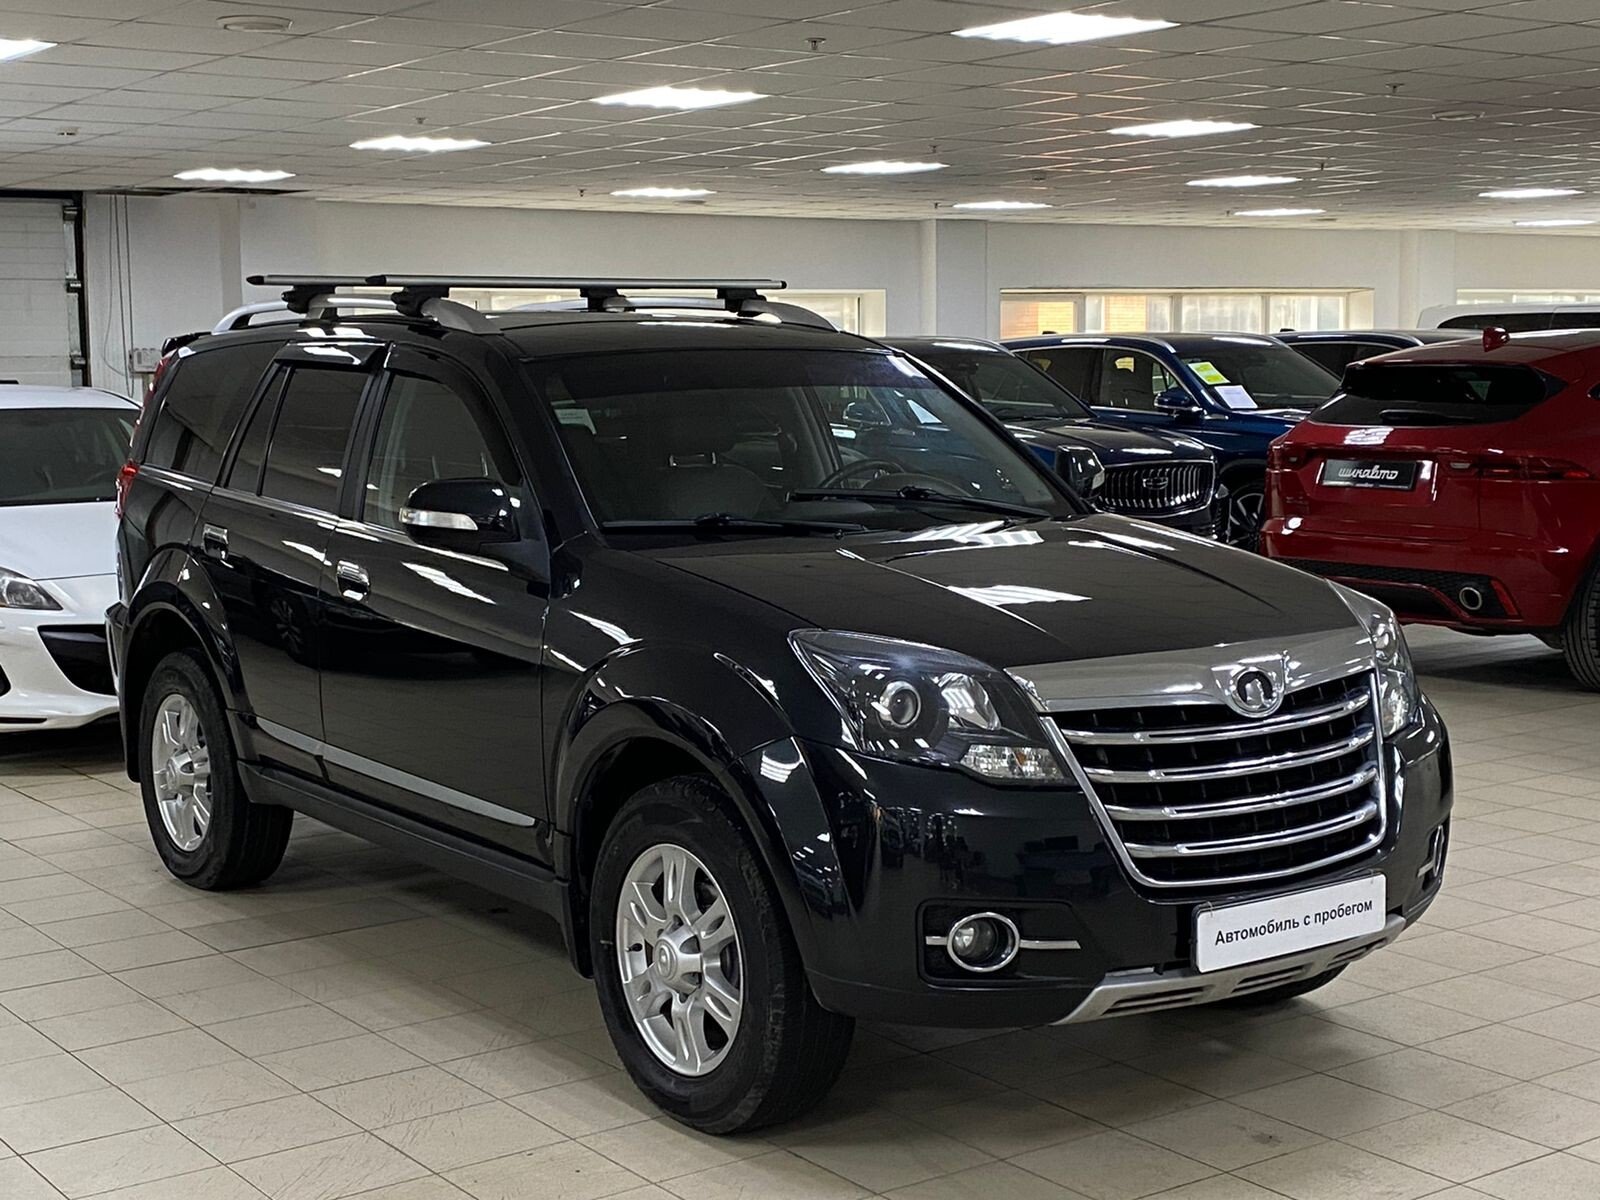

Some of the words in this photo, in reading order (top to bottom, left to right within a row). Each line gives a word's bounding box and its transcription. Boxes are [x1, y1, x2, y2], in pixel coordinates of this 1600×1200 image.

[1215, 919, 1299, 946] Автомобиль
[1303, 914, 1311, 926] с
[1314, 900, 1373, 925] пробегом
